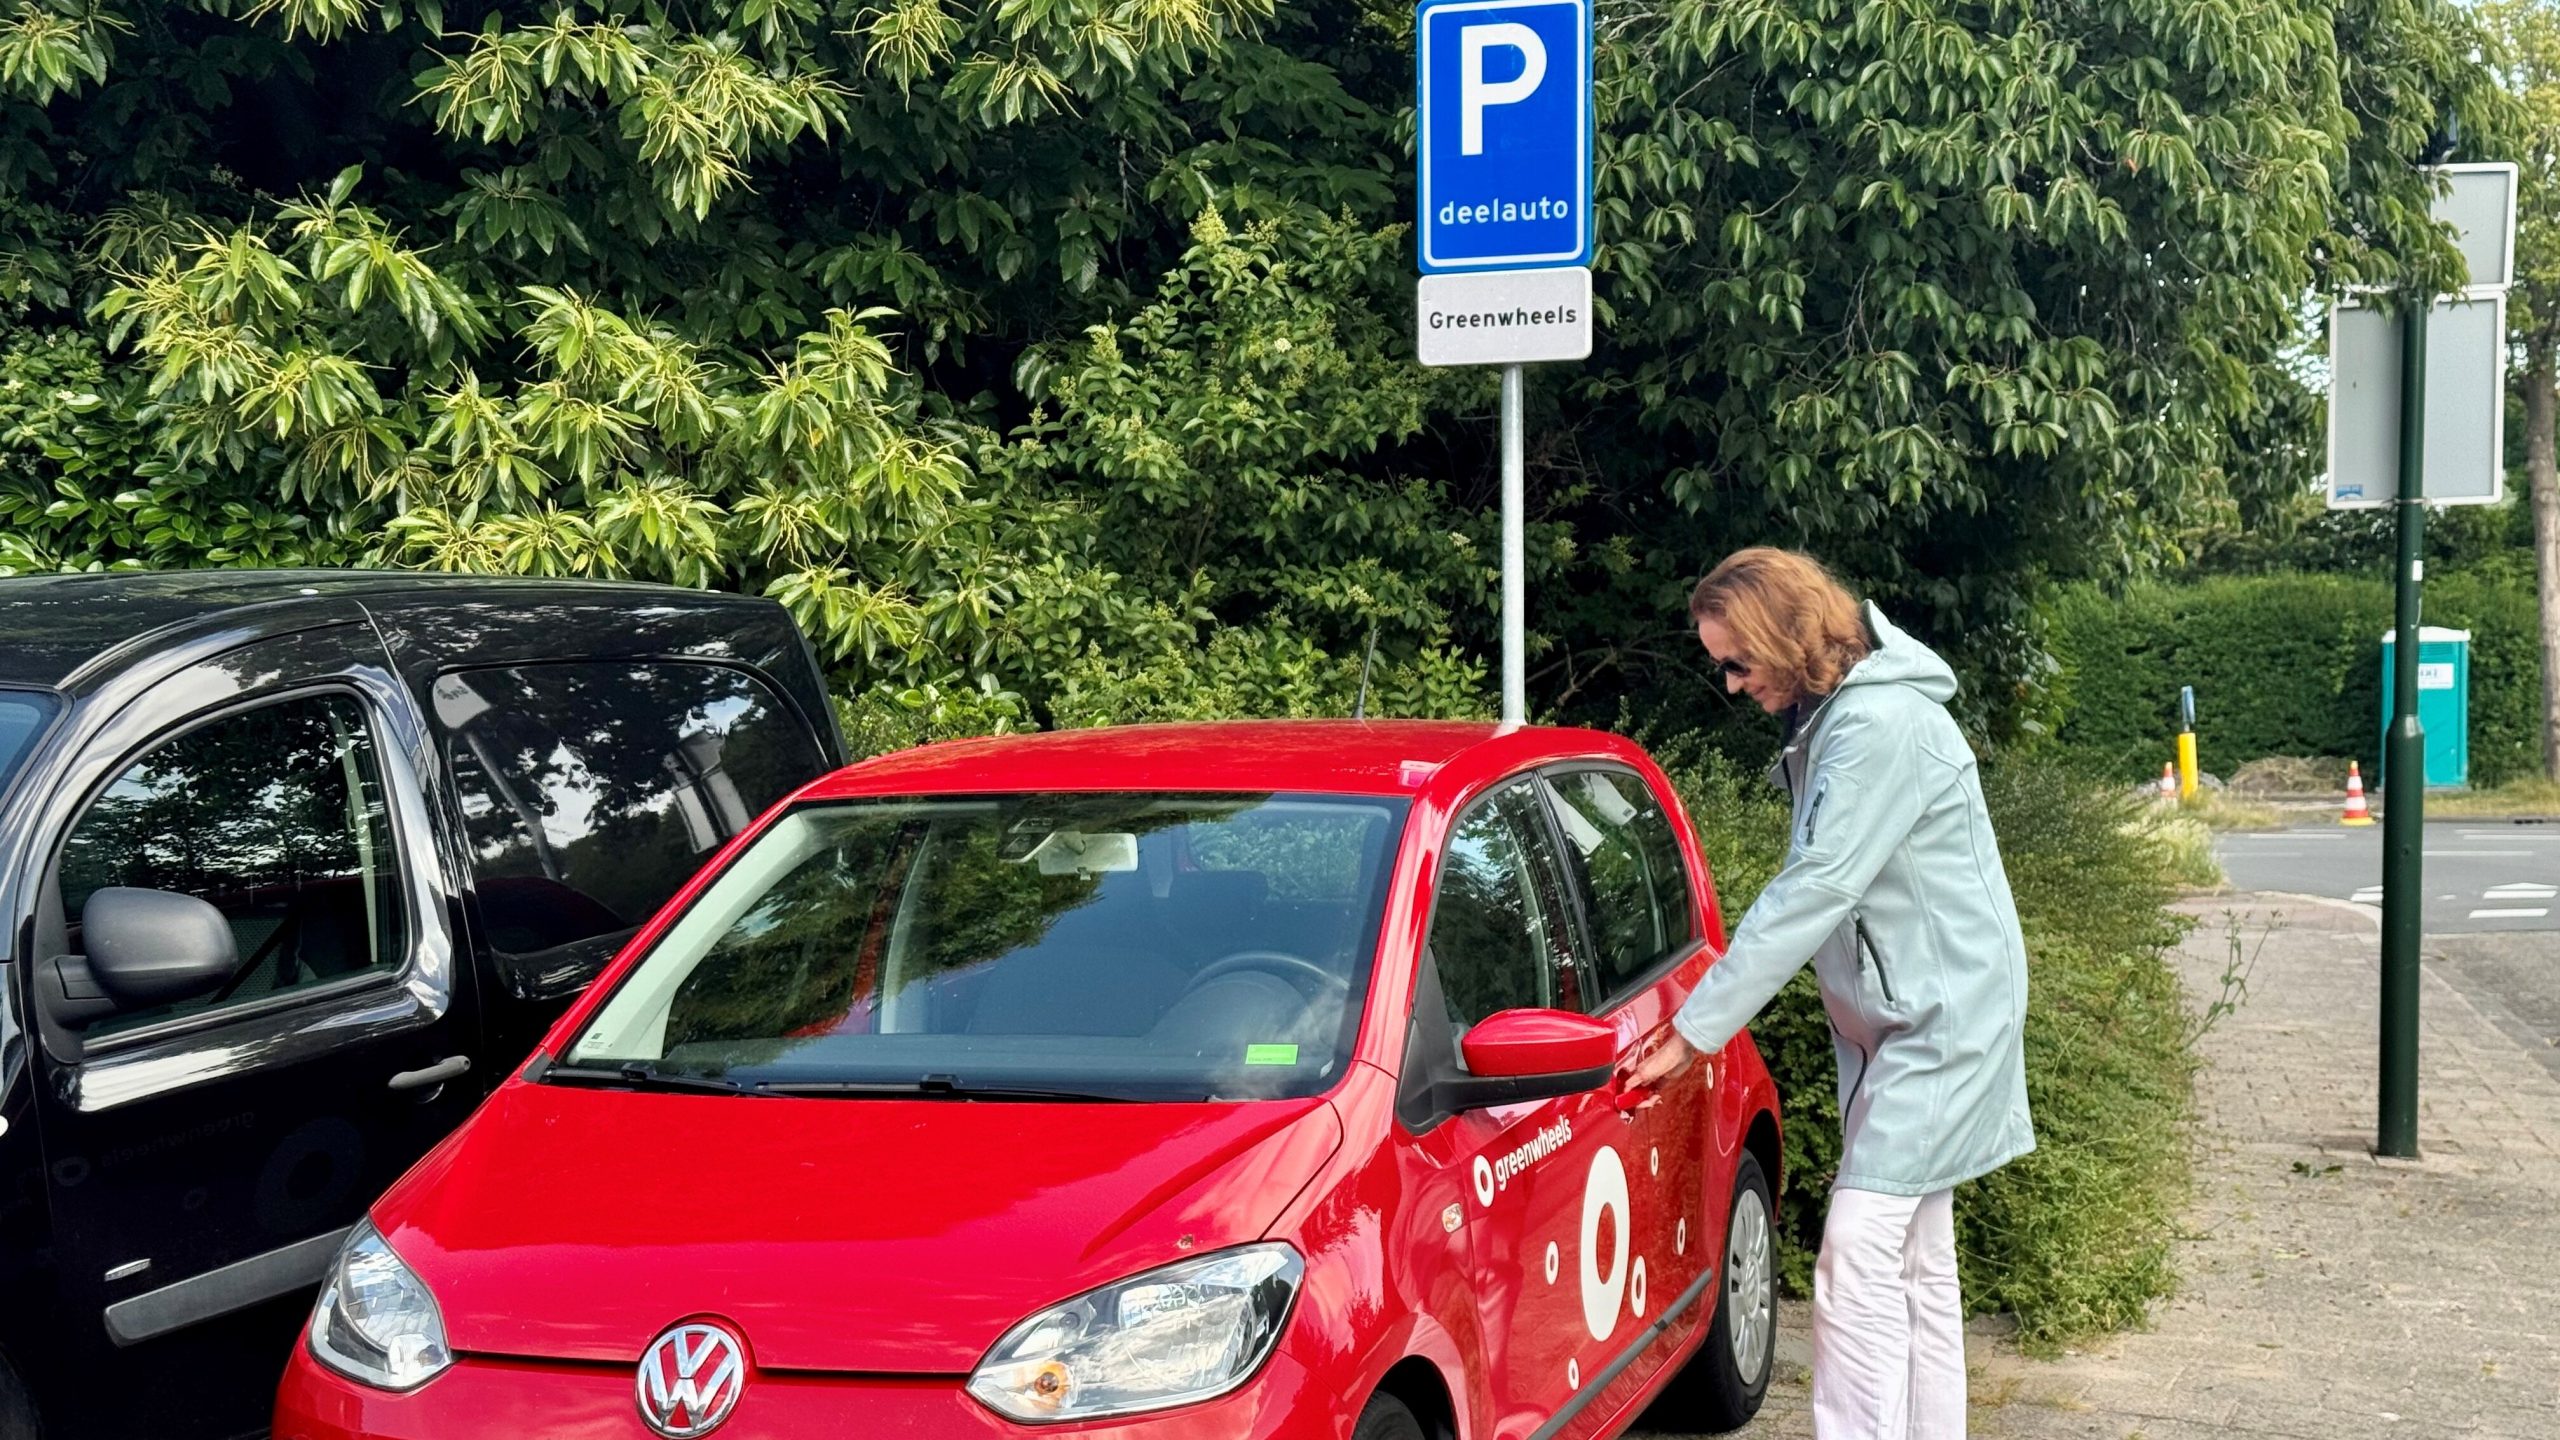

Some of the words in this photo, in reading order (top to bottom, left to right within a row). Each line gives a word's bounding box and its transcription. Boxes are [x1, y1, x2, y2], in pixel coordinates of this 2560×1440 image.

[1461, 22, 1547, 156] P
[1439, 196, 1569, 225] deelauto
[1430, 305, 1577, 329] Greenwheels
[1495, 1114, 1572, 1191] greenwheels
